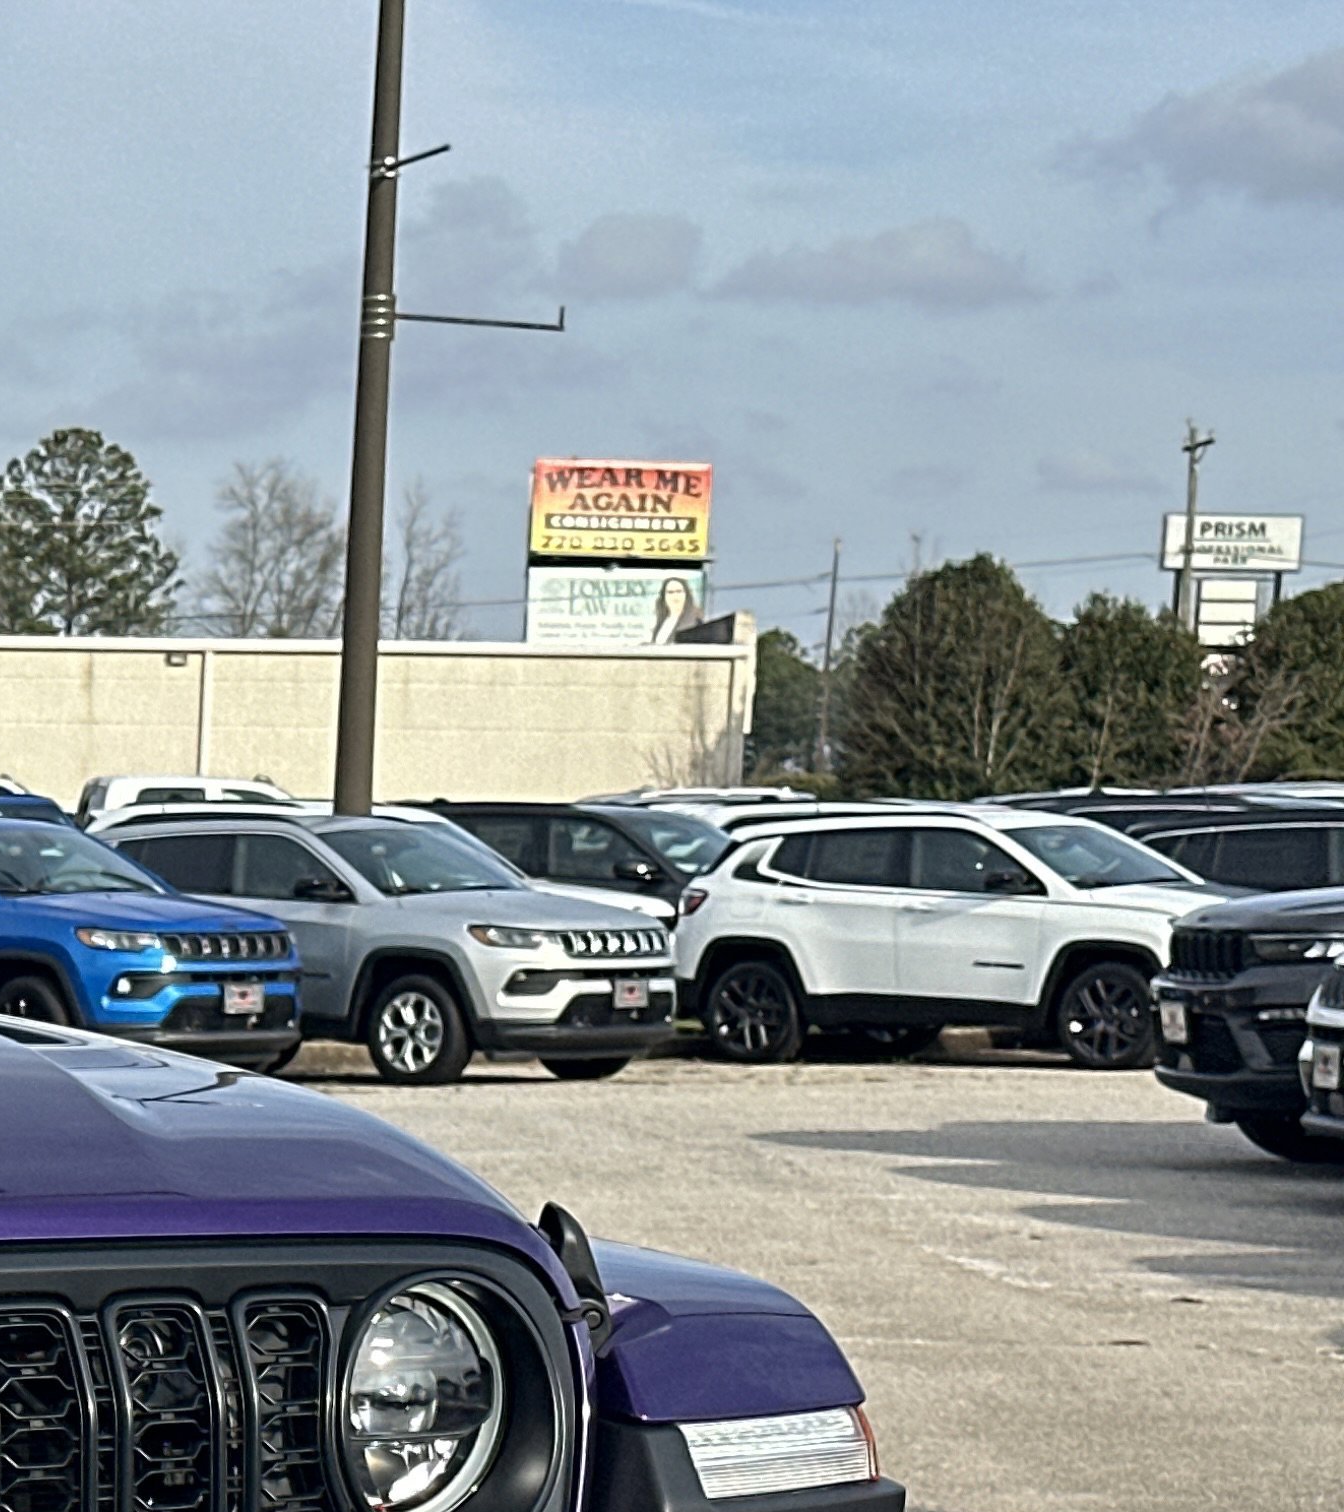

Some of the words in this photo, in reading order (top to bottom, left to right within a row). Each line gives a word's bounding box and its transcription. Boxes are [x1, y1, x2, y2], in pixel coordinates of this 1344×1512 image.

[545, 468, 645, 492] WEAR
[654, 470, 702, 497] ME
[569, 493, 674, 513] AGAIN
[1200, 521, 1267, 539] PRISM
[569, 579, 648, 598] LOWERY
[569, 598, 608, 617] LAW
